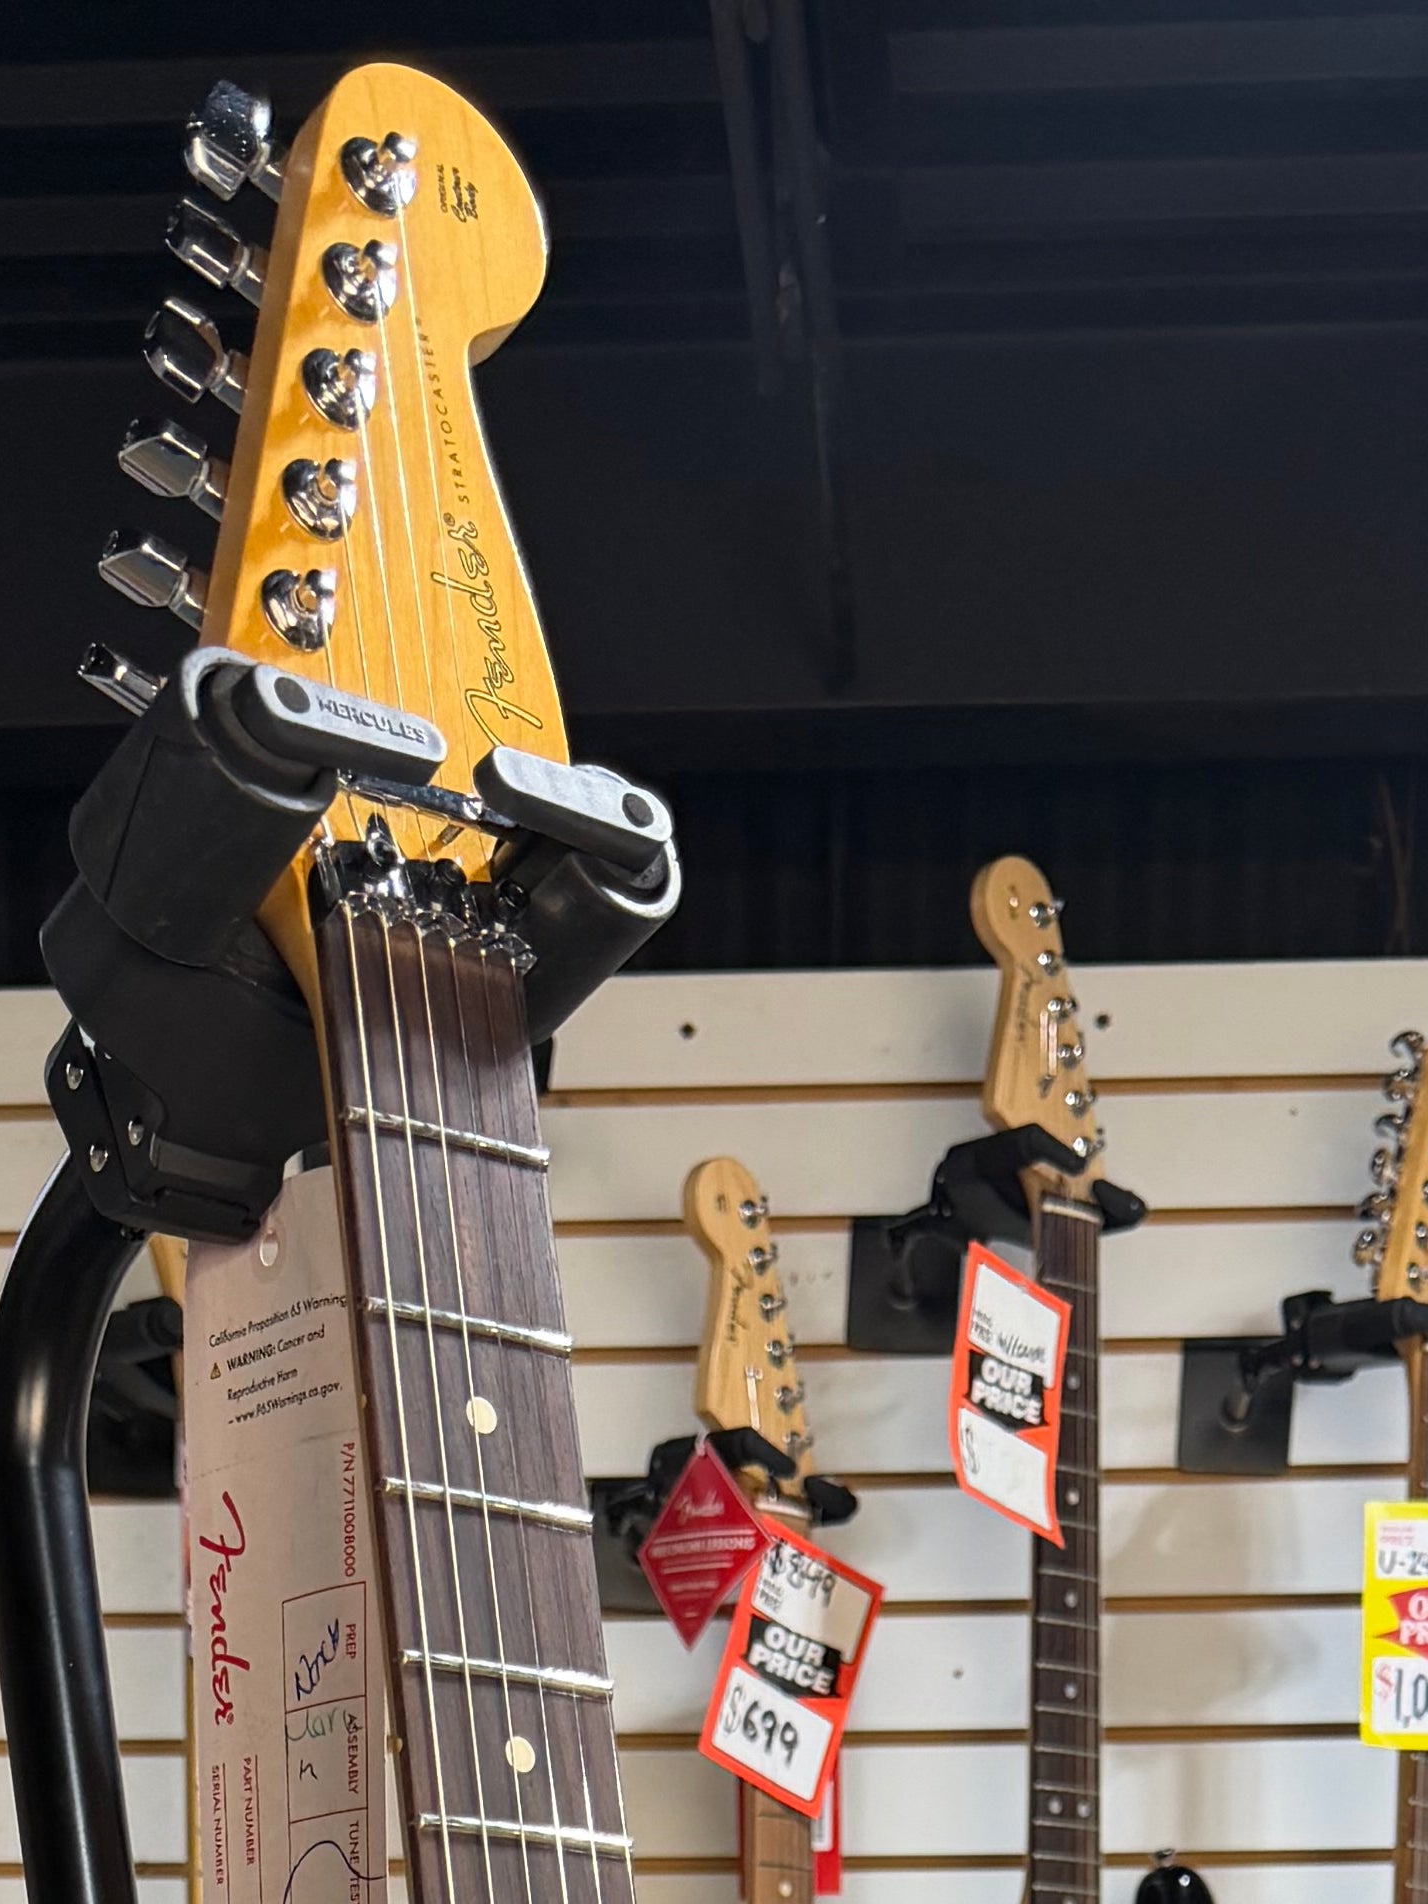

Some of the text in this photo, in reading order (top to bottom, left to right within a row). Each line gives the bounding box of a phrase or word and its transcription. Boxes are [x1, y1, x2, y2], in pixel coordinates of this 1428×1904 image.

[316, 695, 427, 745] HERCULES
[247, 1310, 290, 1335] Proposition
[290, 1300, 302, 1319] 65
[302, 1293, 349, 1313] Warning
[226, 1323, 326, 1372] WARNING: Cancer and
[226, 1374, 275, 1403] Reproductive
[980, 1356, 1034, 1397] OUR
[971, 1379, 1043, 1426] PRICE
[341, 1441, 358, 1578] P/N 7711008000
[197, 1490, 250, 1727] Fender
[344, 1622, 358, 1661] PREP
[763, 1624, 827, 1666] OUR
[748, 1642, 836, 1696] PRICE
[723, 1684, 800, 1770] $699
[346, 1712, 361, 1796] ASSEMBLY
[210, 1763, 225, 1887] SERIAL NUMBER
[242, 1756, 257, 1867] PART NUMBER
